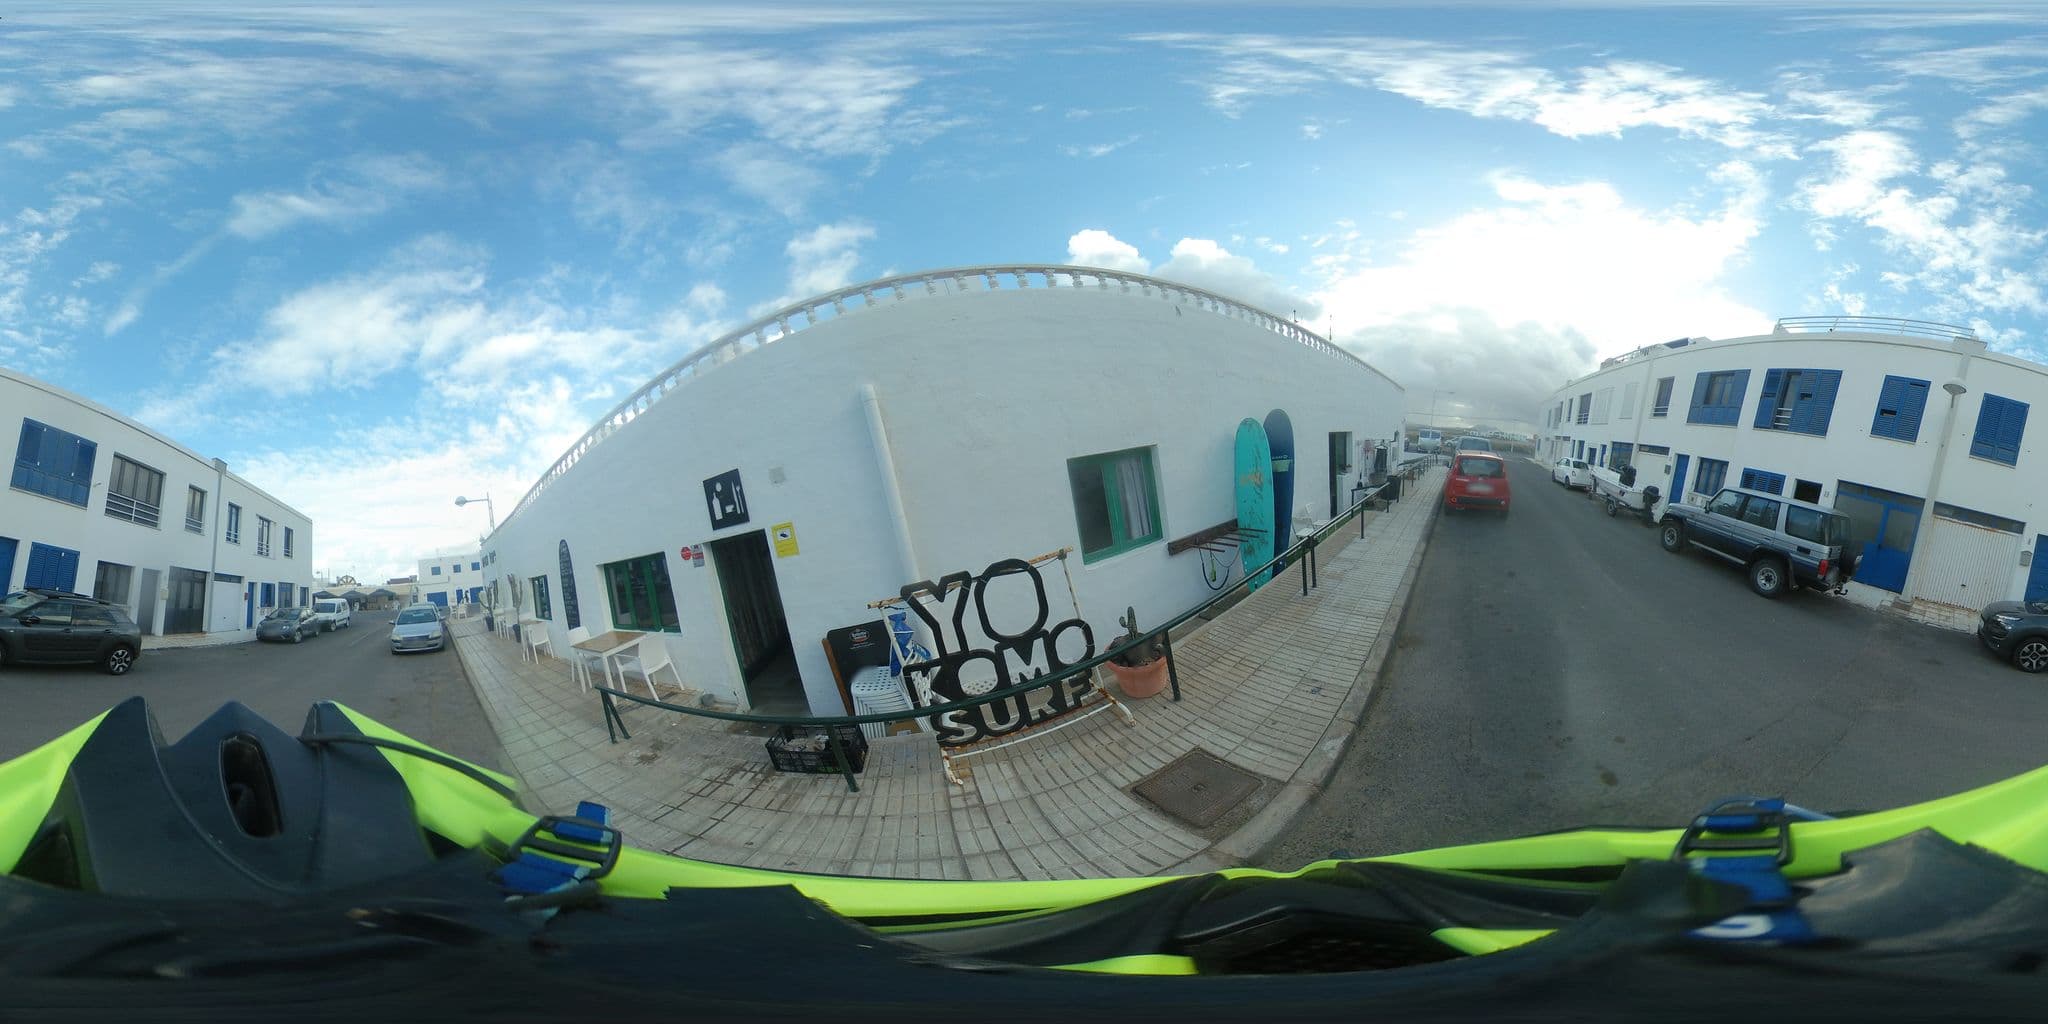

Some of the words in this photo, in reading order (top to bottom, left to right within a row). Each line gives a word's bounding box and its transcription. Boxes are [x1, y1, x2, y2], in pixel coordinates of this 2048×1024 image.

[901, 558, 1048, 653] YO
[903, 618, 1094, 706] KOMO
[930, 676, 1093, 746] SURF
